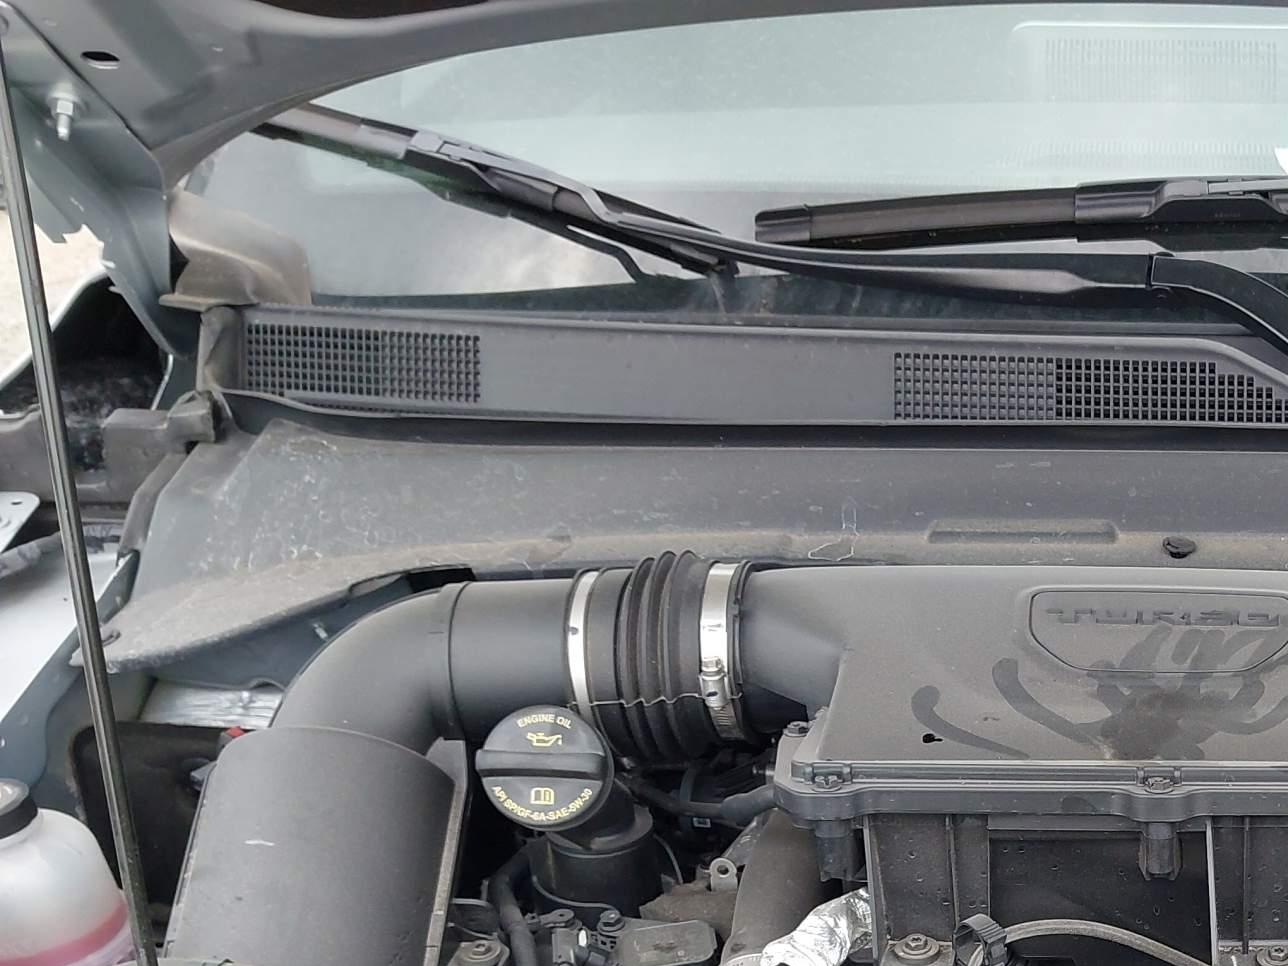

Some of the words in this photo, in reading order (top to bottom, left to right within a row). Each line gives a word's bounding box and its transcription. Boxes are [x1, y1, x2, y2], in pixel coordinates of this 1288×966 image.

[516, 713, 555, 728] ENGINE
[556, 715, 572, 729] OIL
[491, 786, 508, 802] API
